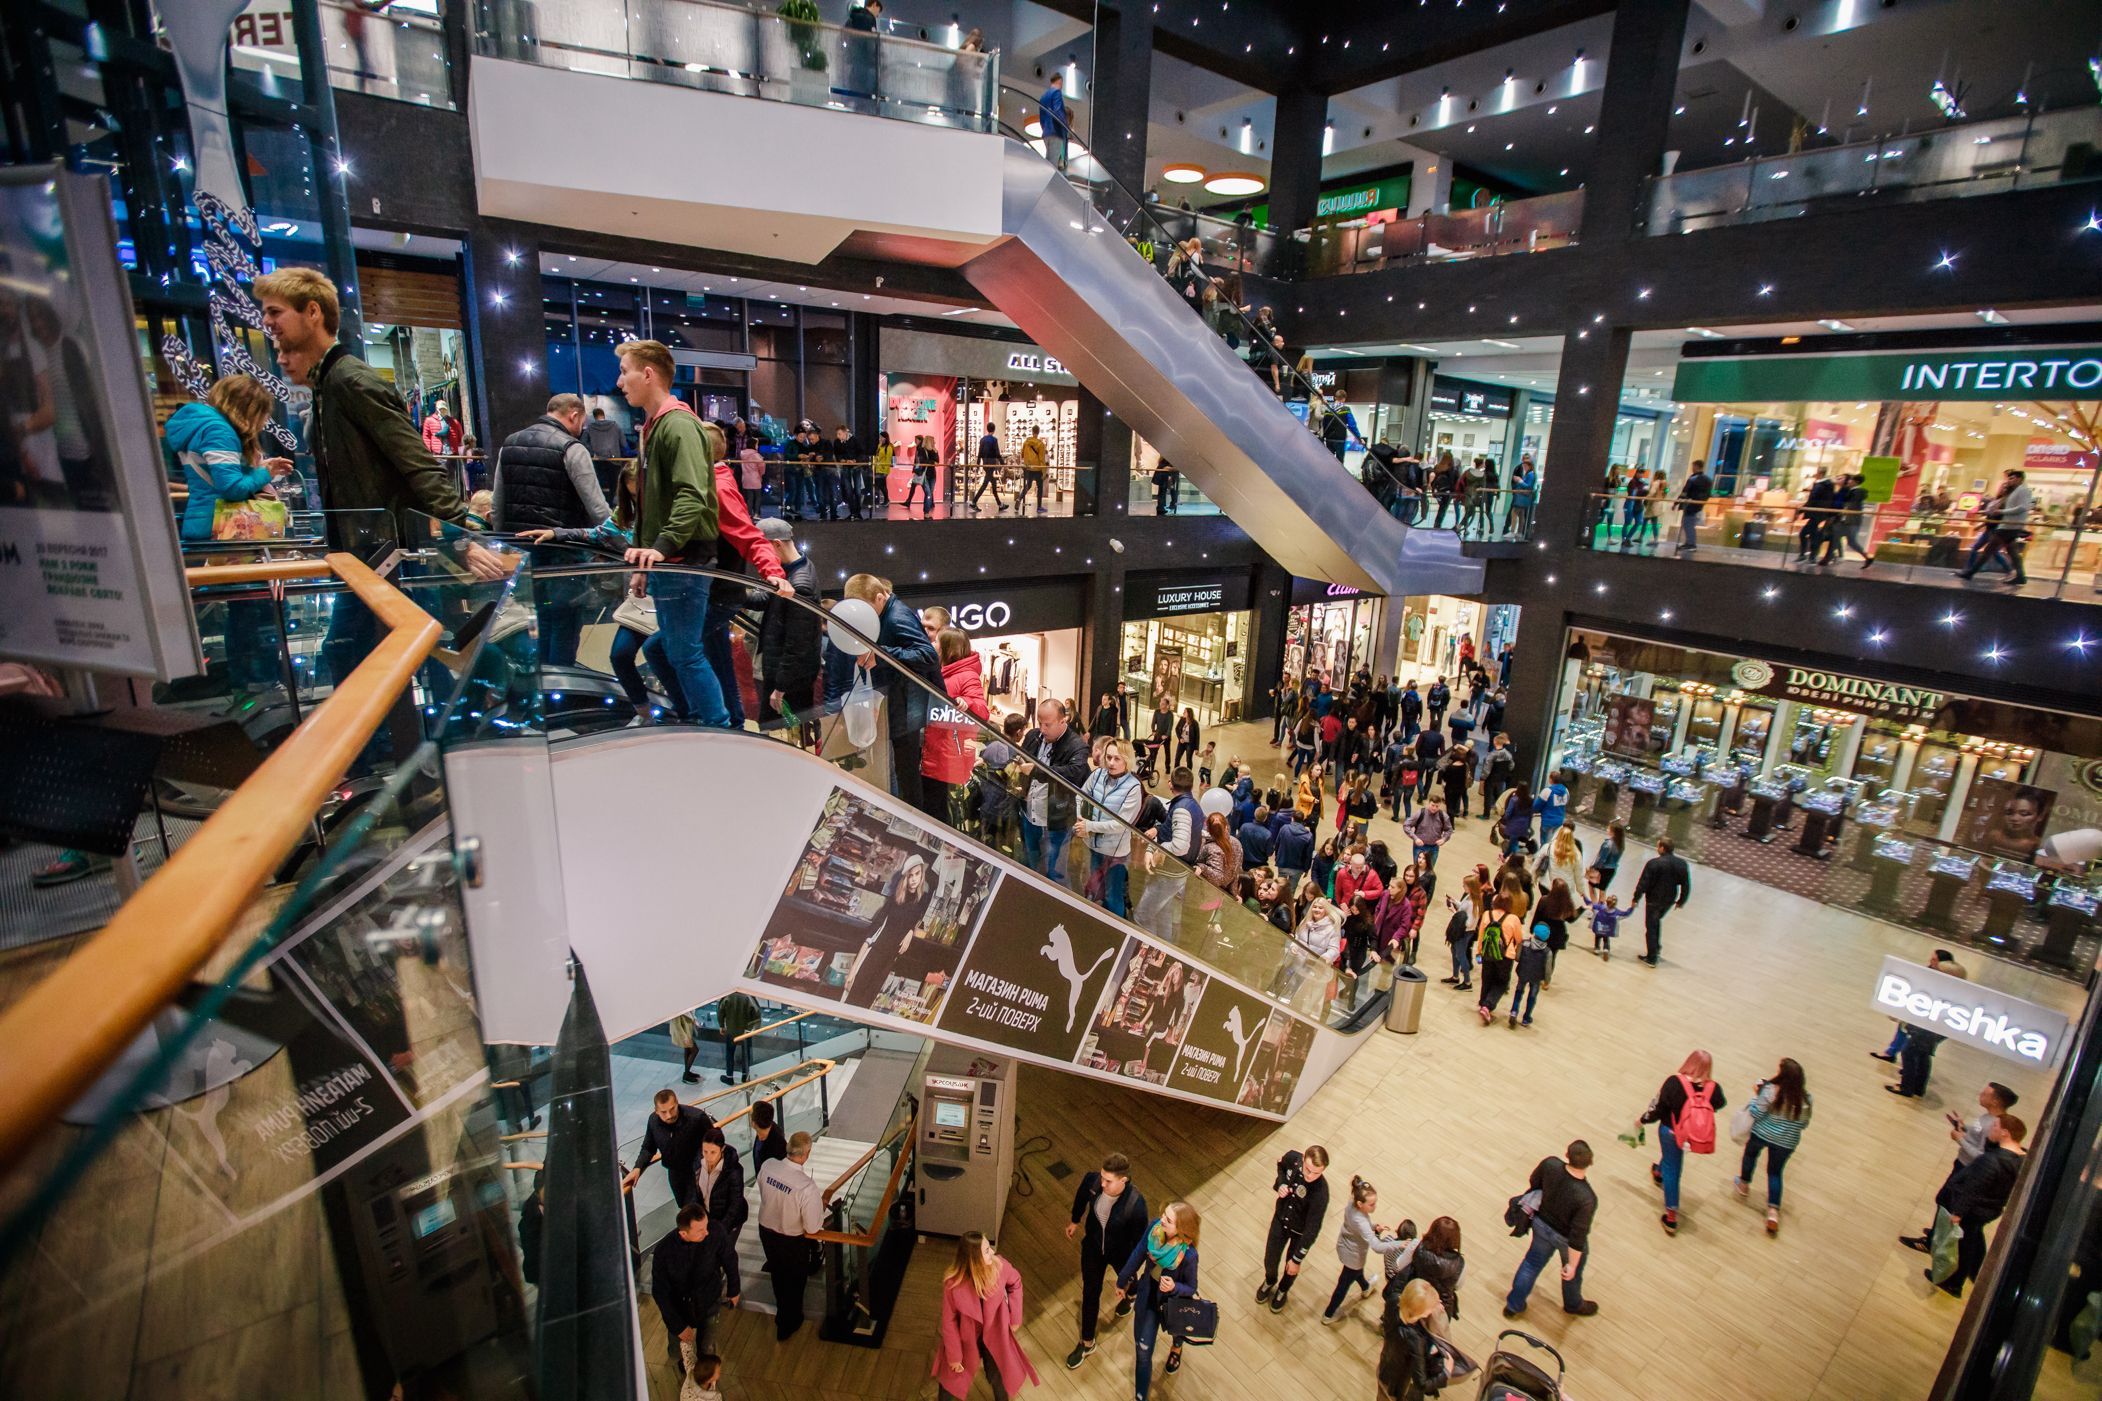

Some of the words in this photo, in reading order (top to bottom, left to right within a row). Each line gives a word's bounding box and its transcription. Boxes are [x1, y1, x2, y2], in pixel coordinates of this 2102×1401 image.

[1008, 353, 1042, 370] ALL
[1901, 359, 2102, 390] INTERTO
[1157, 592, 1192, 604] LUXURY
[1193, 590, 1222, 601] HOUSE
[1786, 685, 1891, 711] ЮВЕЛІРНИЙ
[1787, 668, 1944, 709] DOMINANT
[963, 969, 1021, 1002] МАГАЗИН
[1017, 987, 1050, 1012] PUMA
[965, 997, 999, 1020] 2-ий
[996, 1005, 1043, 1033] ПОВЕРХ
[1877, 974, 2049, 1061] Bershka
[1181, 1044, 1211, 1064] МАГАЗИН
[1208, 1052, 1227, 1069] PUMA
[1195, 1066, 1222, 1084] ПОВЕРХ
[766, 1176, 792, 1195] SECURITY
